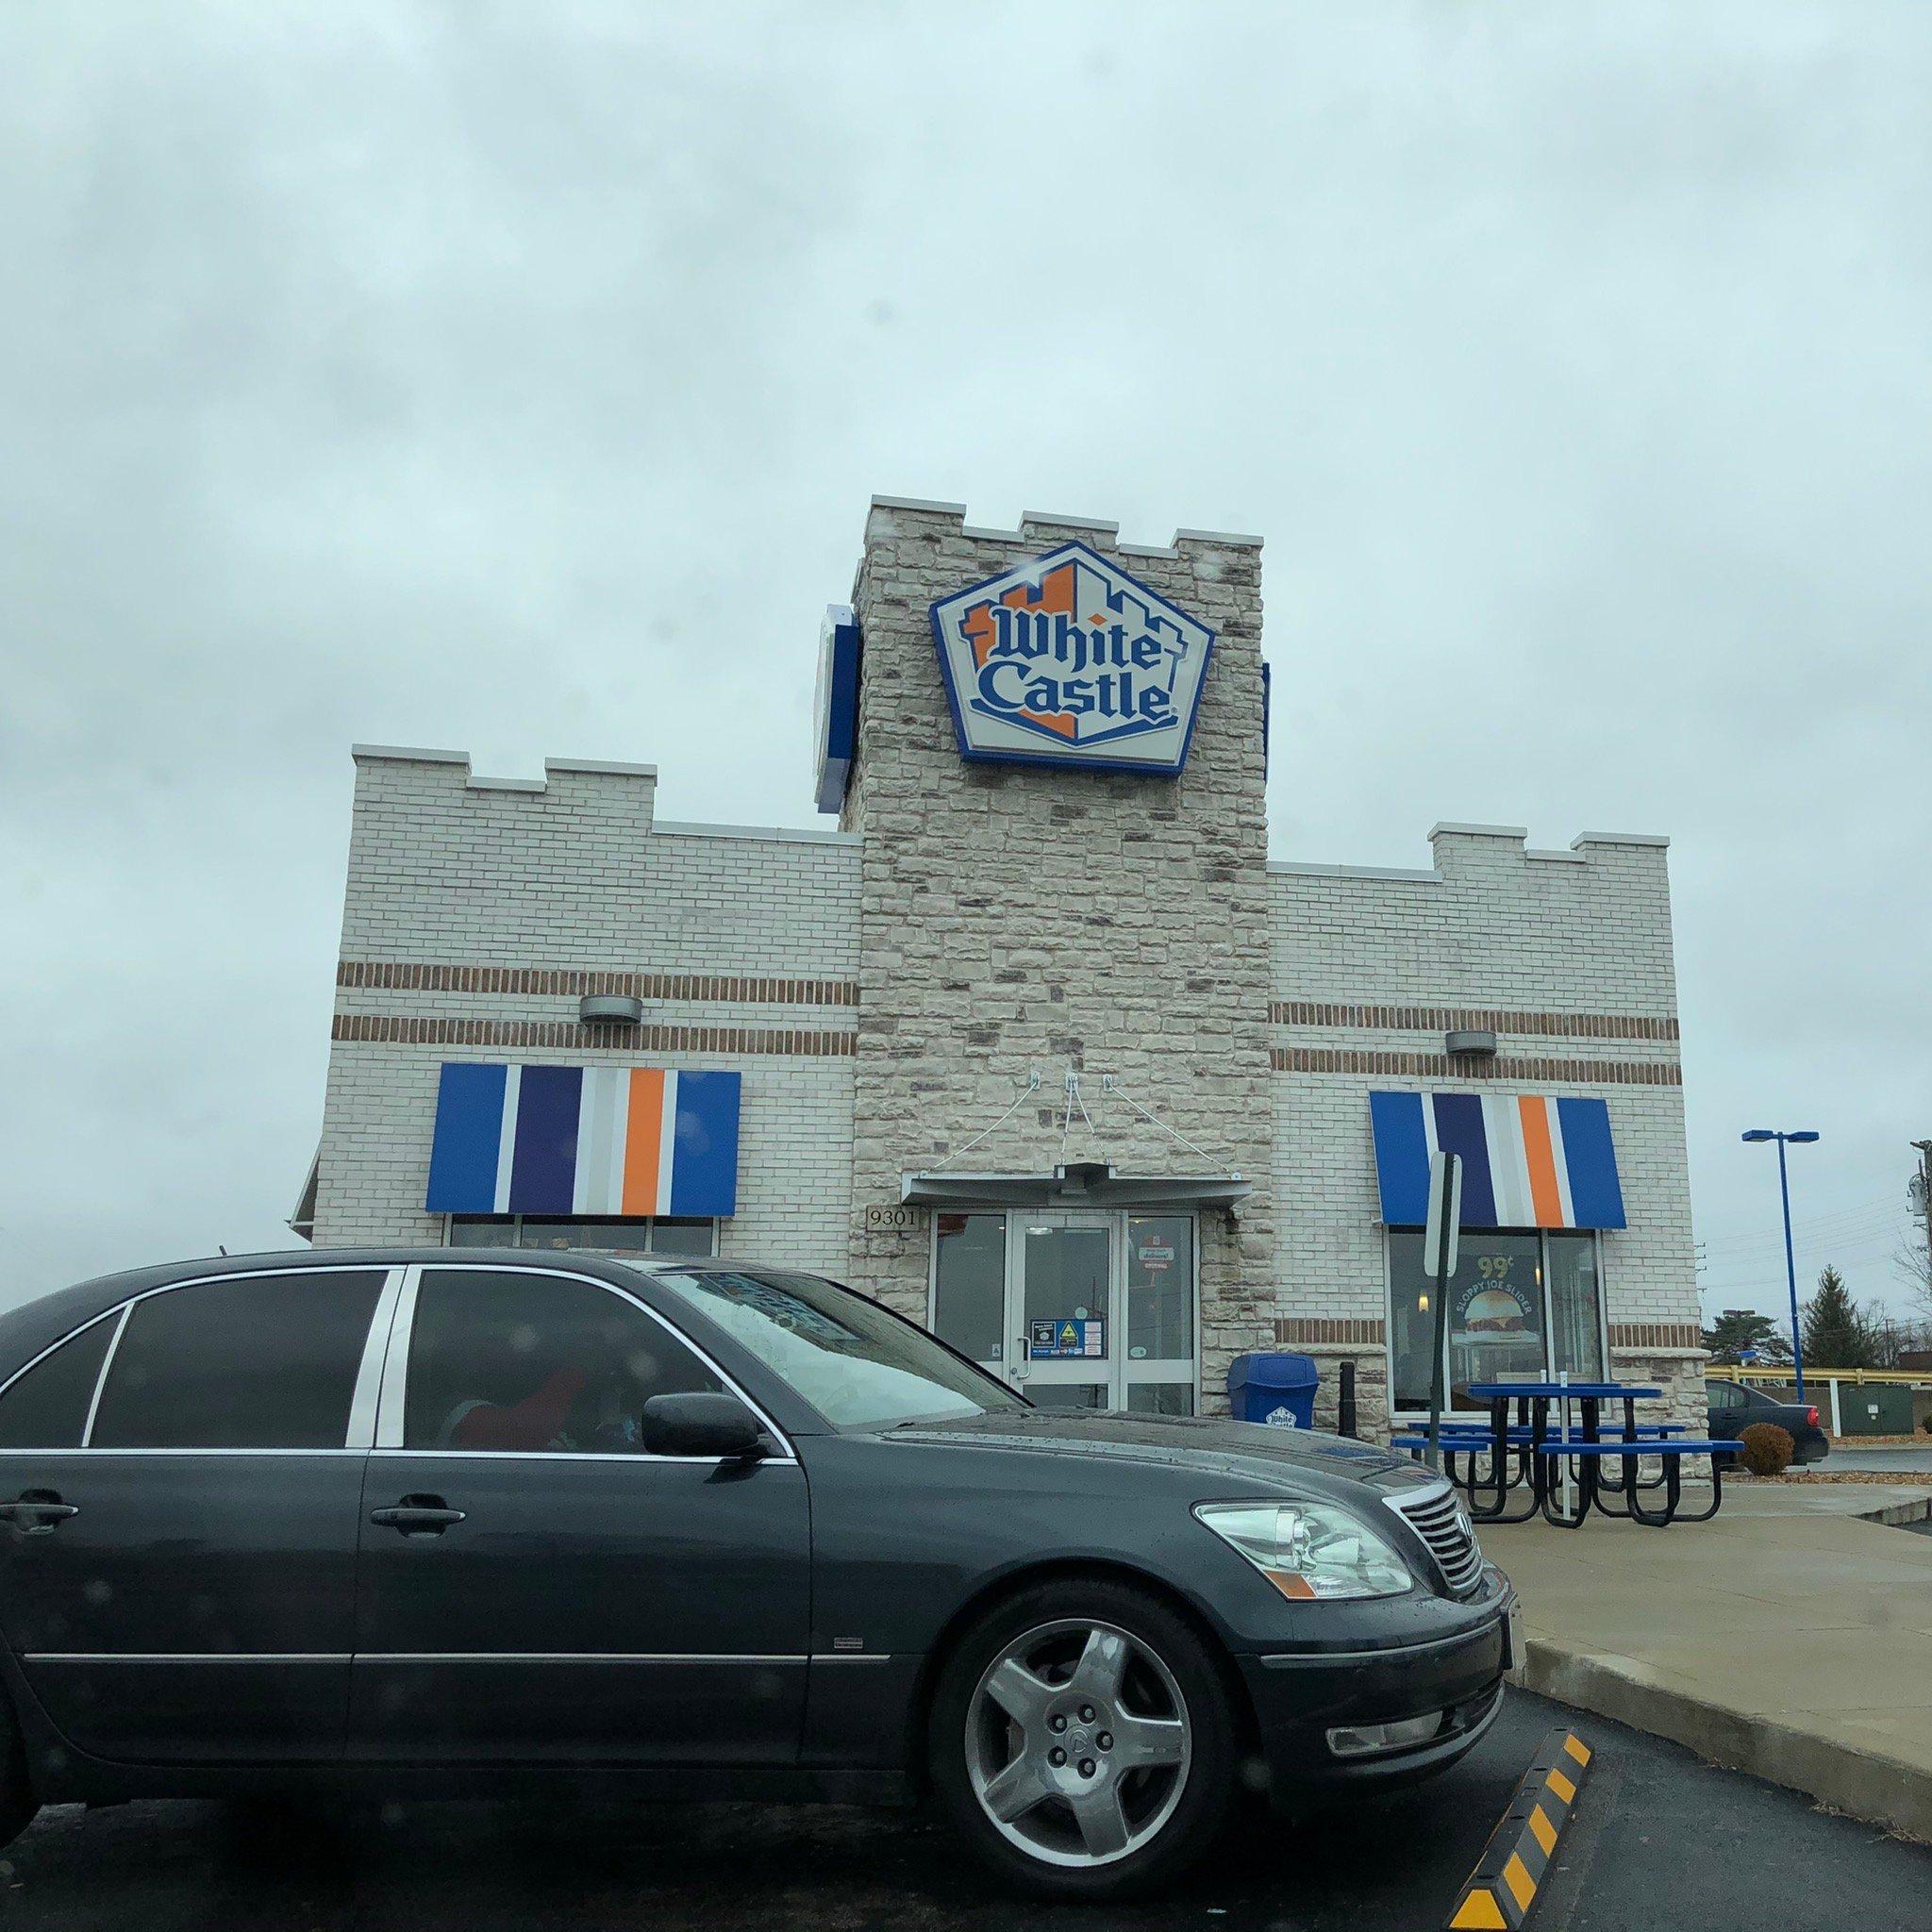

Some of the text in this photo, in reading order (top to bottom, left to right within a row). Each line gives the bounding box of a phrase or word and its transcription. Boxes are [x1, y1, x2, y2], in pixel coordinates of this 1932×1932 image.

[990, 608, 1161, 673] White
[978, 660, 1171, 721] Castle
[870, 1209, 916, 1225] 9301
[1456, 1280, 1532, 1313] SLOPPY JOE SLIDER
